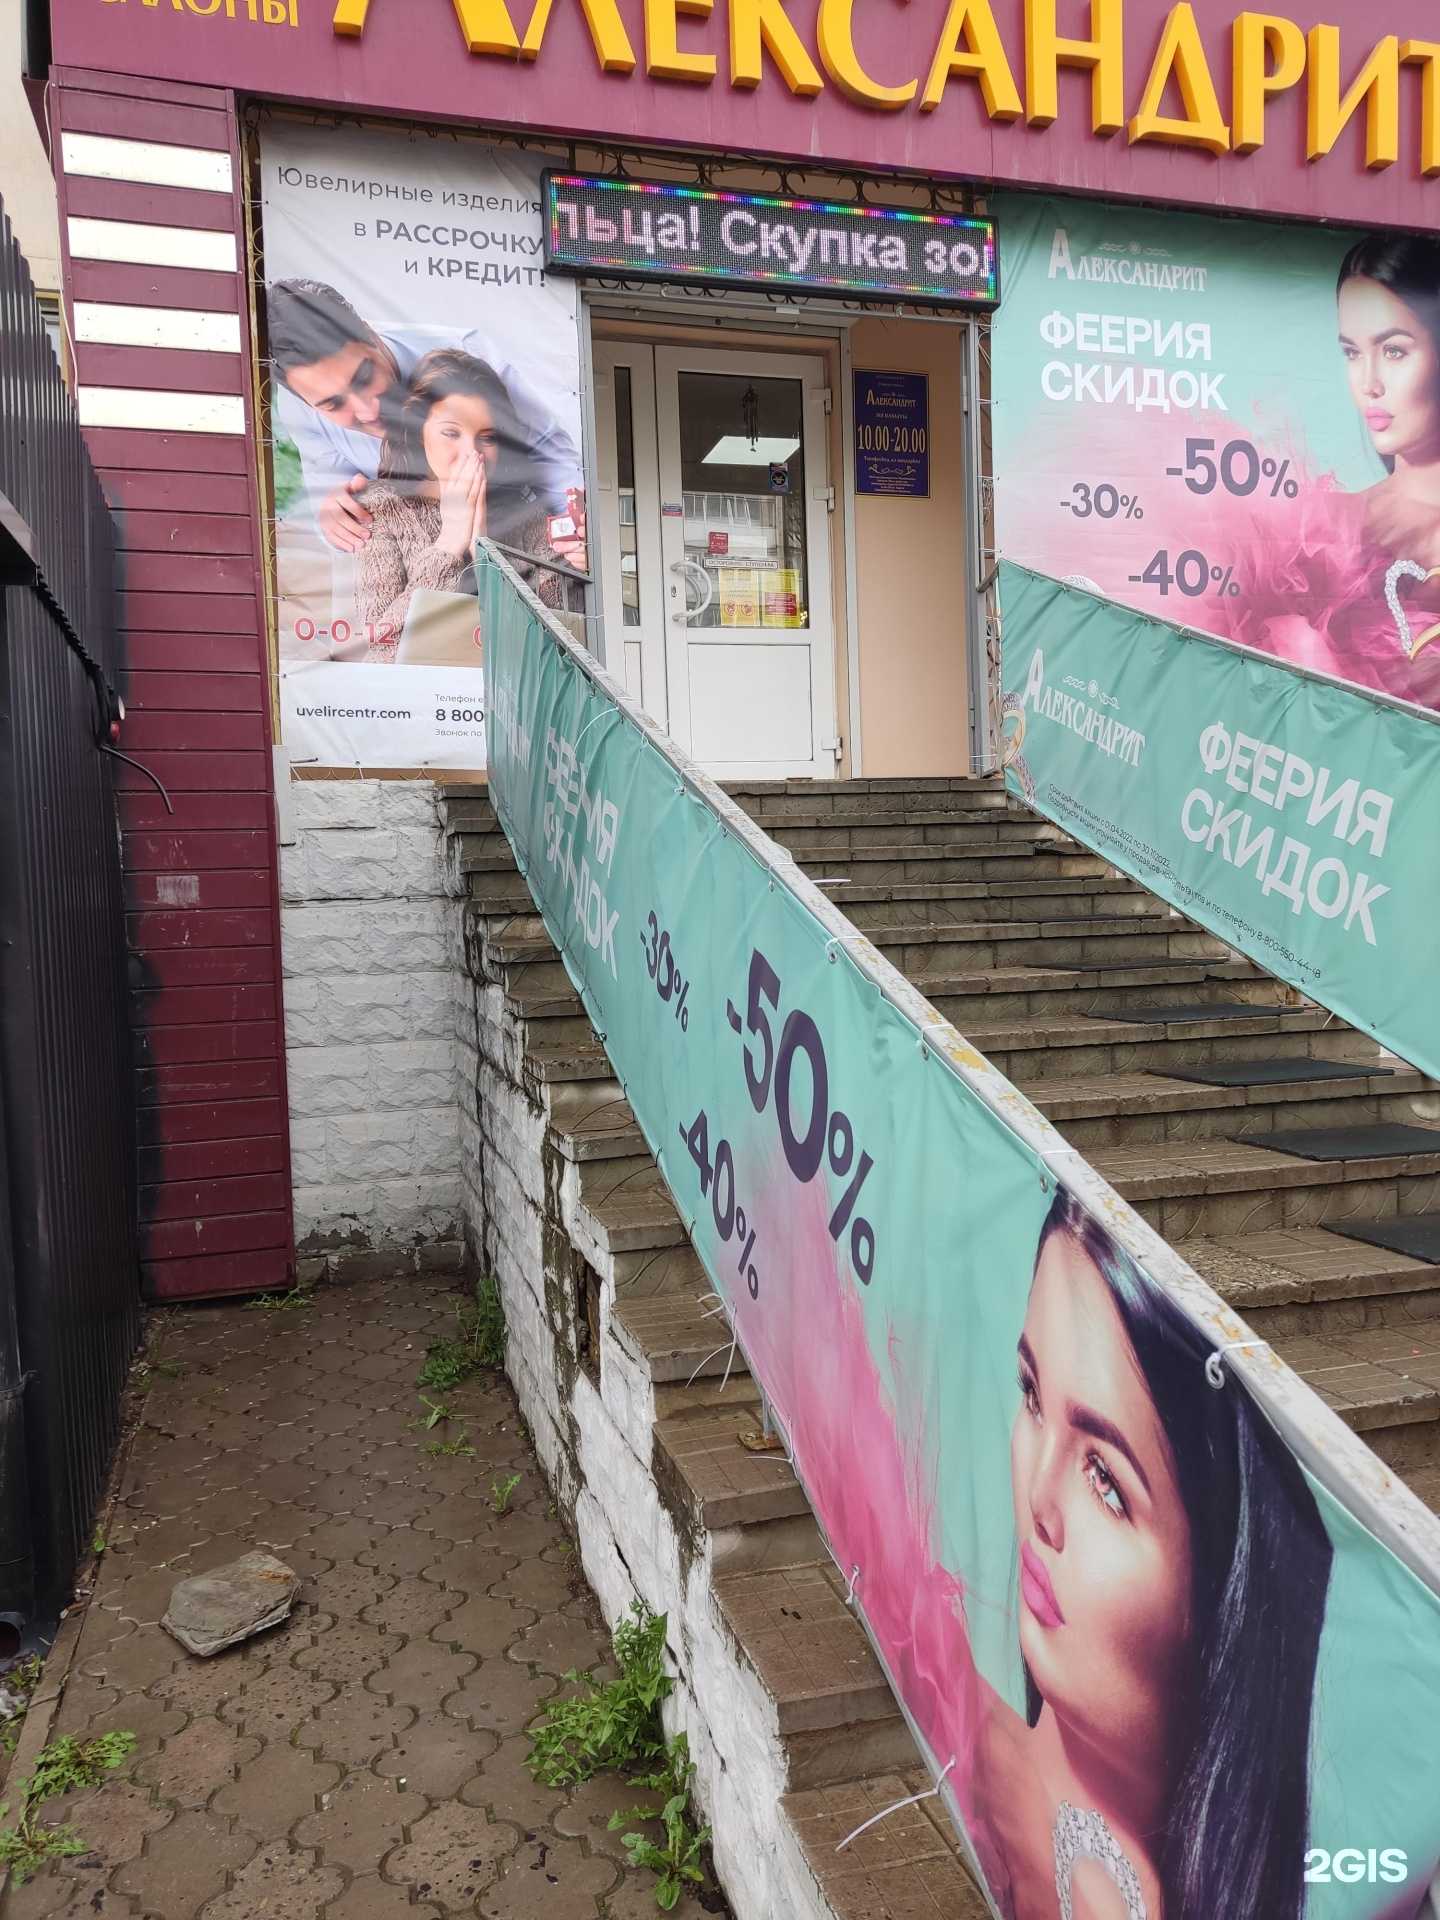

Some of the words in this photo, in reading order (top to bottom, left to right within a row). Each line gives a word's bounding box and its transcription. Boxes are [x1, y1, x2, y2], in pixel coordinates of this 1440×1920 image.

[278, 166, 433, 201] Ювелирные
[442, 191, 542, 215] изделия
[353, 222, 367, 237] в
[376, 219, 543, 256] РАССРОЧКУ
[719, 210, 908, 272] Скупка
[1047, 228, 1208, 292] АЛЕКСАНДРИТ
[404, 259, 418, 275] и
[428, 257, 546, 287] КРЕДИТ!
[1039, 310, 1212, 361] ФЕЕРИЯ
[1040, 360, 1229, 413] СКИДОК
[1165, 437, 1299, 499] -50%
[1060, 482, 1144, 520] -30%
[1128, 549, 1240, 597] -40%
[296, 704, 411, 719] uvelircentr.com
[435, 693, 476, 704] Телефон
[435, 709, 446, 721] 8
[451, 709, 484, 722] 800
[1023, 648, 1146, 768] АЛЕКСАНДРИТ
[435, 728, 467, 737] Звонок
[544, 727, 619, 879] ФЕЕИЯ
[1199, 720, 1393, 857] ФЕЕРИЯ
[1180, 788, 1391, 946] СКИДОК
[639, 909, 689, 1033] -30%
[726, 946, 876, 1287] -50%
[678, 1108, 759, 1301] -40%
